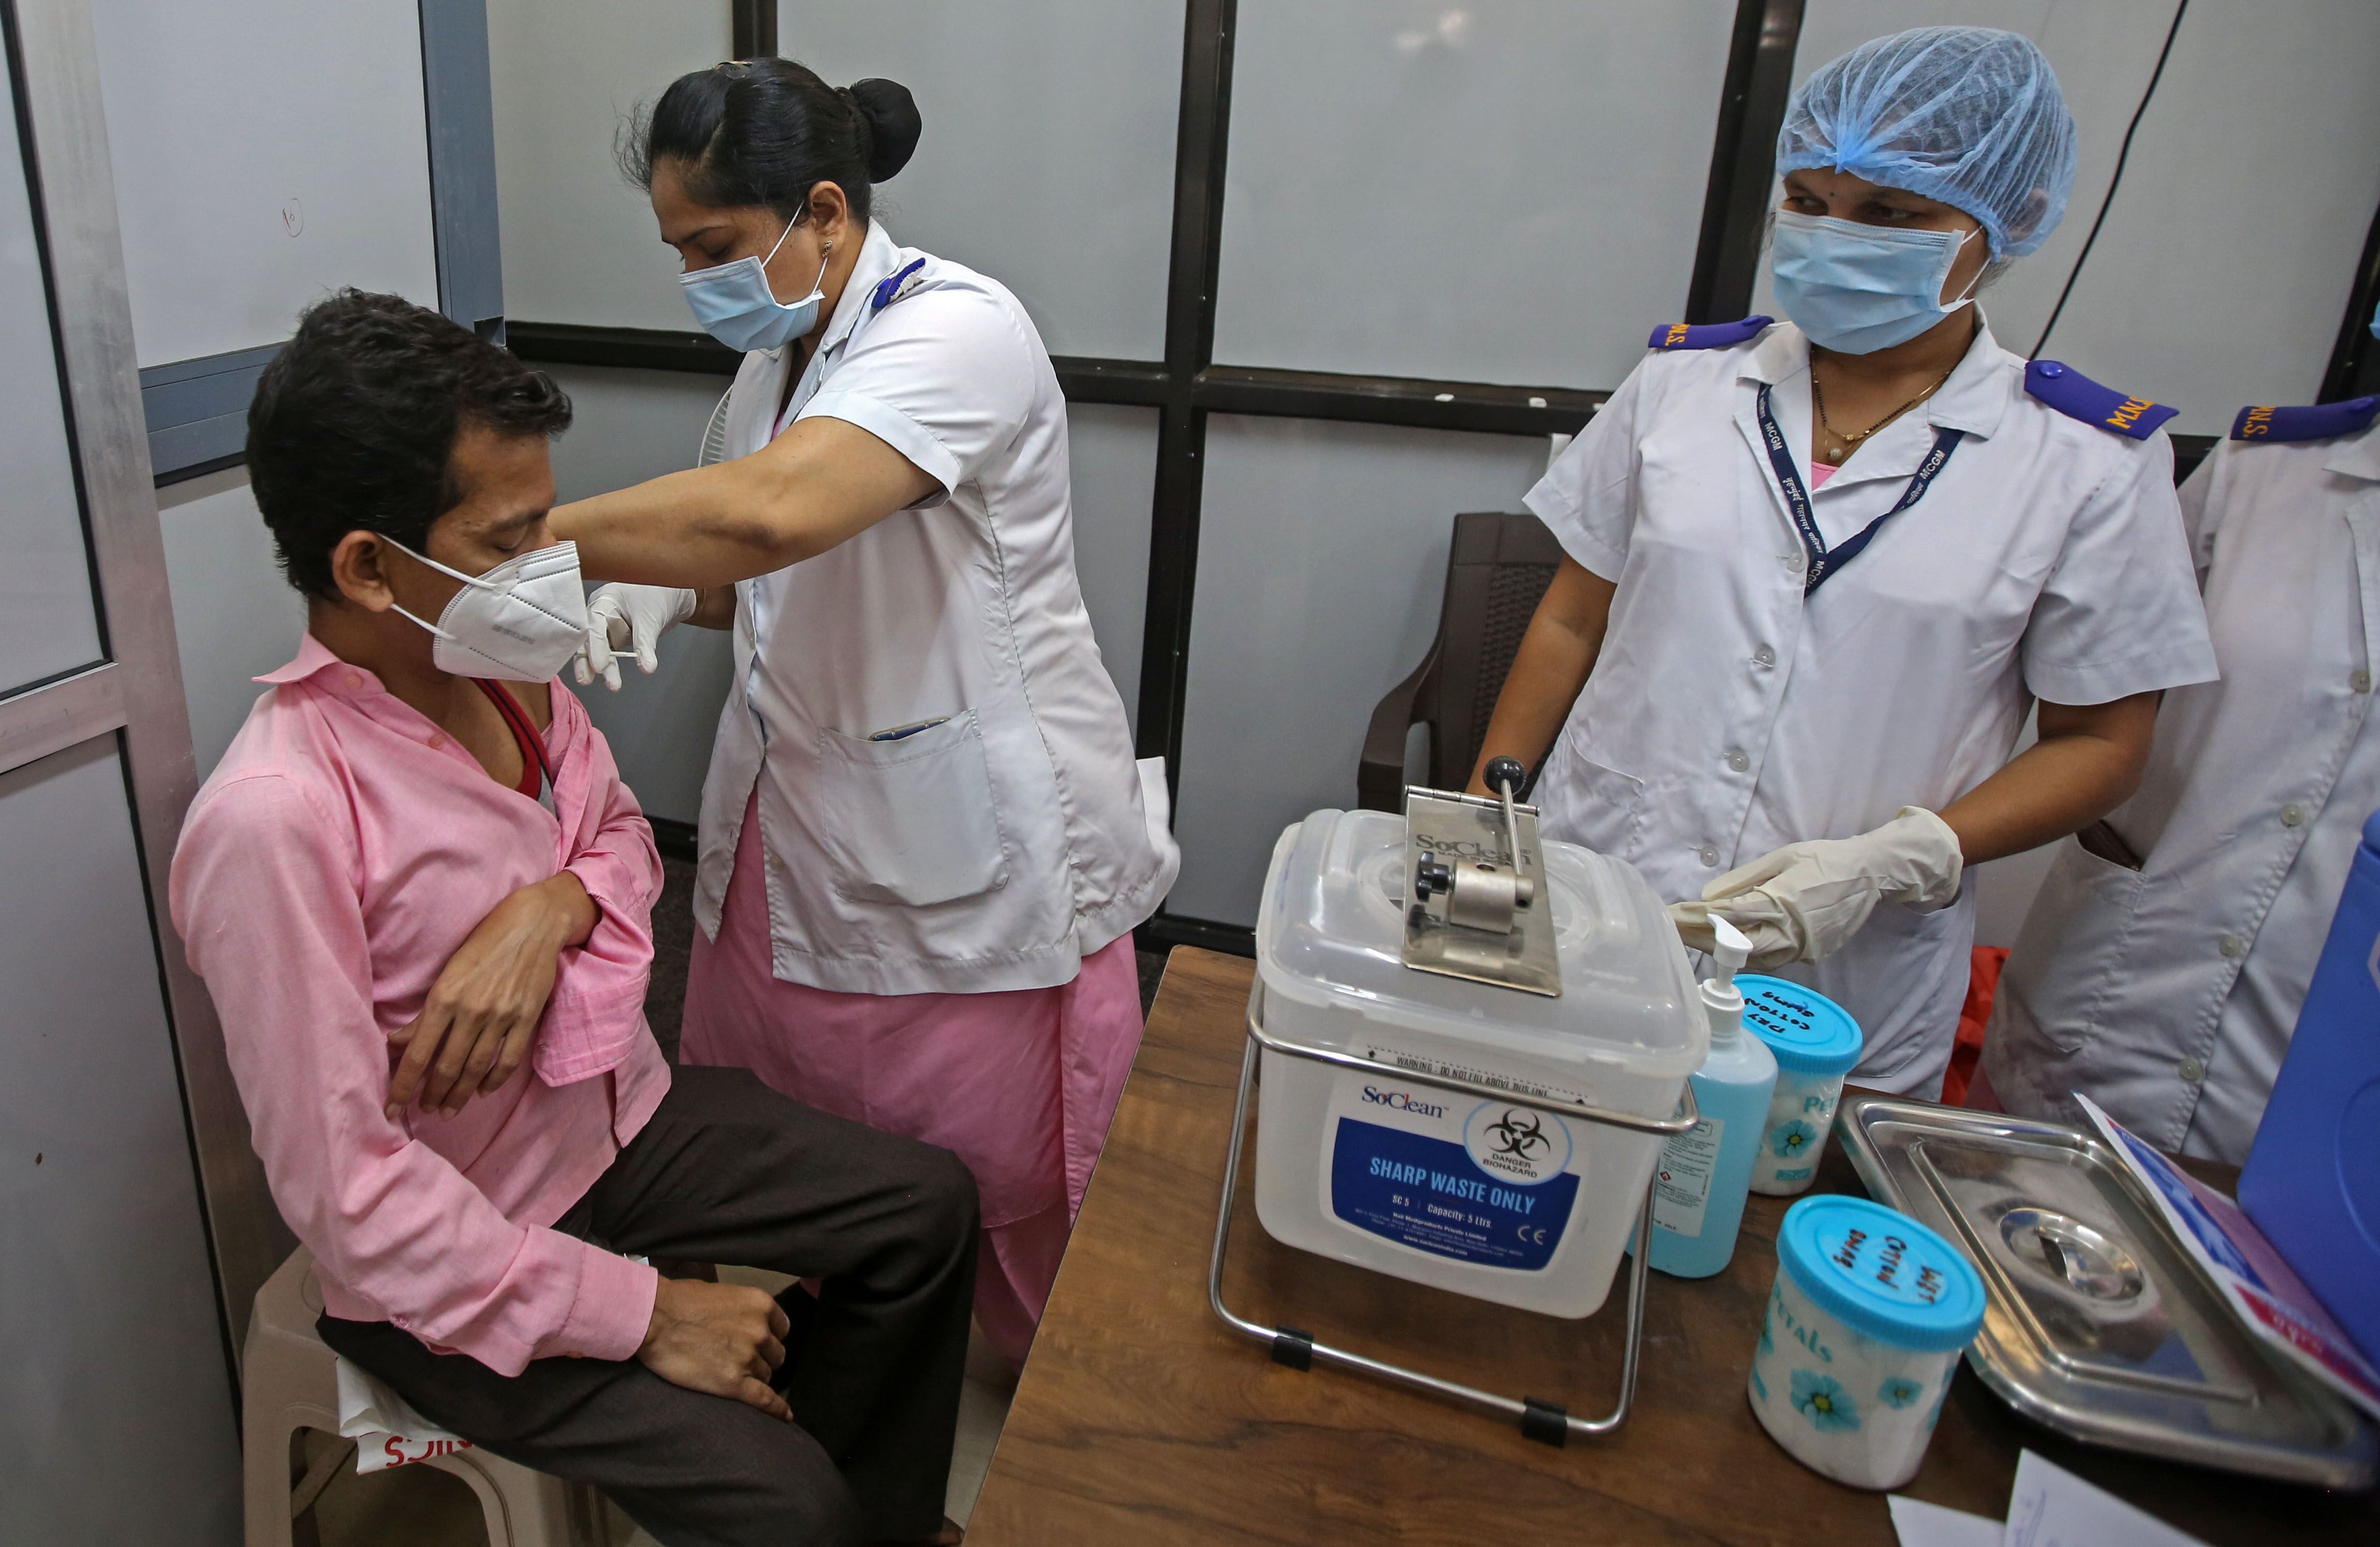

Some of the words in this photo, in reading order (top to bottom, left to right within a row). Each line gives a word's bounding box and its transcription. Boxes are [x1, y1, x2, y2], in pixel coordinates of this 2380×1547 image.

[1765, 422, 1783, 451] MCGM
[1920, 450, 1945, 479] MCGM
[1744, 998, 1810, 1030] COTTON
[1747, 1013, 1785, 1033] DRY
[1397, 1056, 1433, 1072] WARNING
[1440, 1066, 1450, 1075] DO
[1452, 1069, 1467, 1081] NOT
[1513, 1083, 1529, 1094] THIS
[1483, 1159, 1538, 1178] BIOHAZARD
[1492, 1154, 1532, 1169] DANGER
[1371, 1156, 1427, 1186] SHARP
[1431, 1171, 1487, 1203] WASTE
[1490, 1187, 1536, 1214] ONLY
[1392, 1195, 1403, 1205] SC
[1405, 1198, 1409, 1207] 5
[1428, 1204, 1465, 1222] Capacity:
[1468, 1214, 1473, 1223] 5
[1444, 1226, 1464, 1236] Private
[1465, 1231, 1487, 1241] Limited
